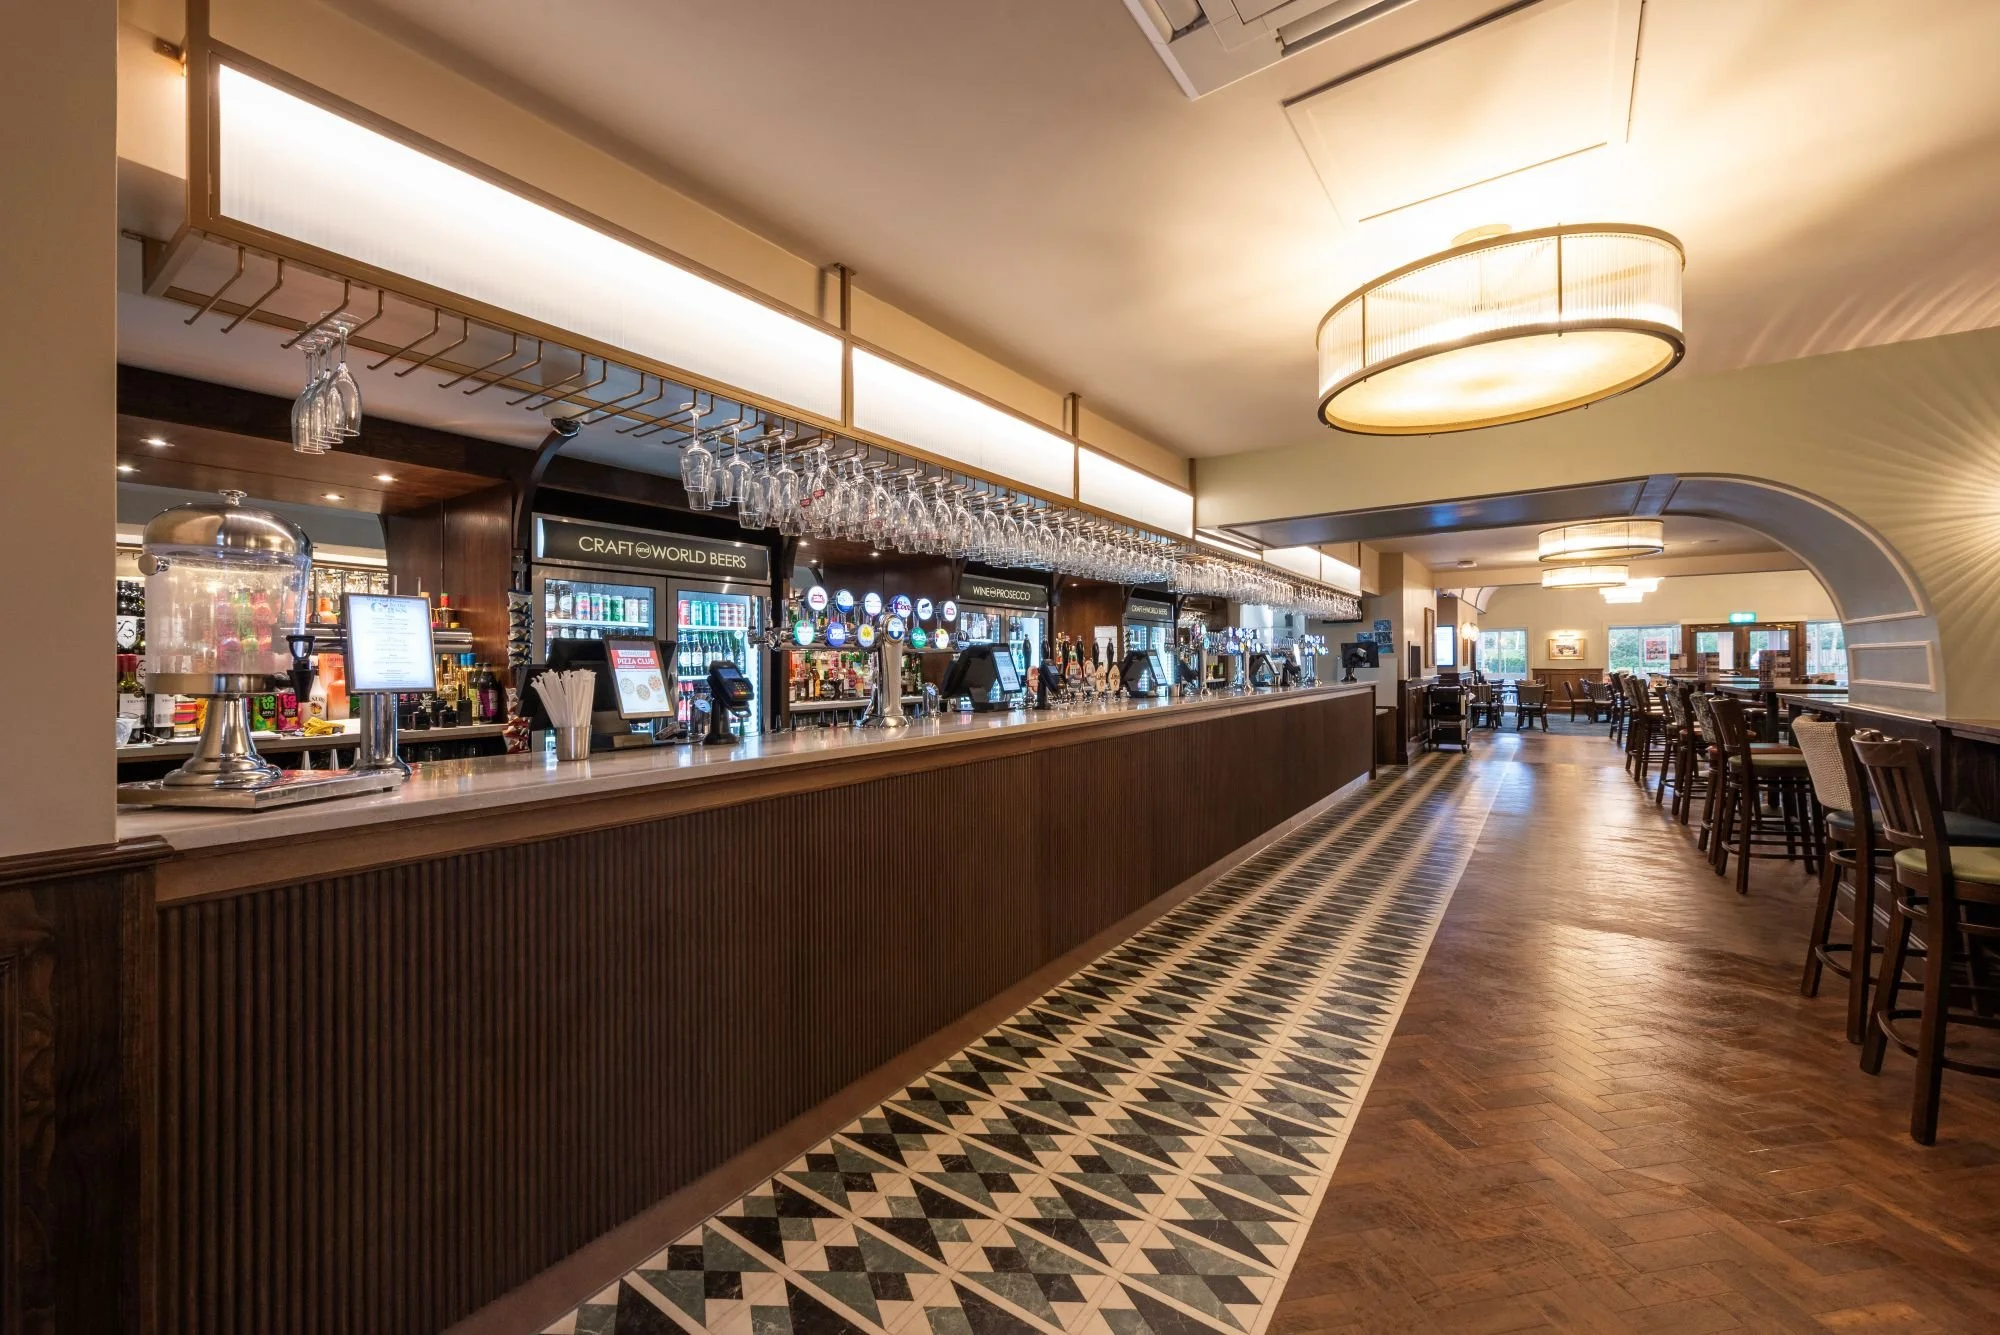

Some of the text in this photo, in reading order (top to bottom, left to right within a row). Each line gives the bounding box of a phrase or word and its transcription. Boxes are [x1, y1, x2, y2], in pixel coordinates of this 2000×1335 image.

[578, 536, 634, 557] CRAFT
[651, 545, 706, 564] WORLD
[710, 552, 747, 569] BEERS
[972, 585, 990, 597] WINE
[996, 589, 1031, 601] PROSECCO
[616, 657, 655, 665] PIZZA CLUB
